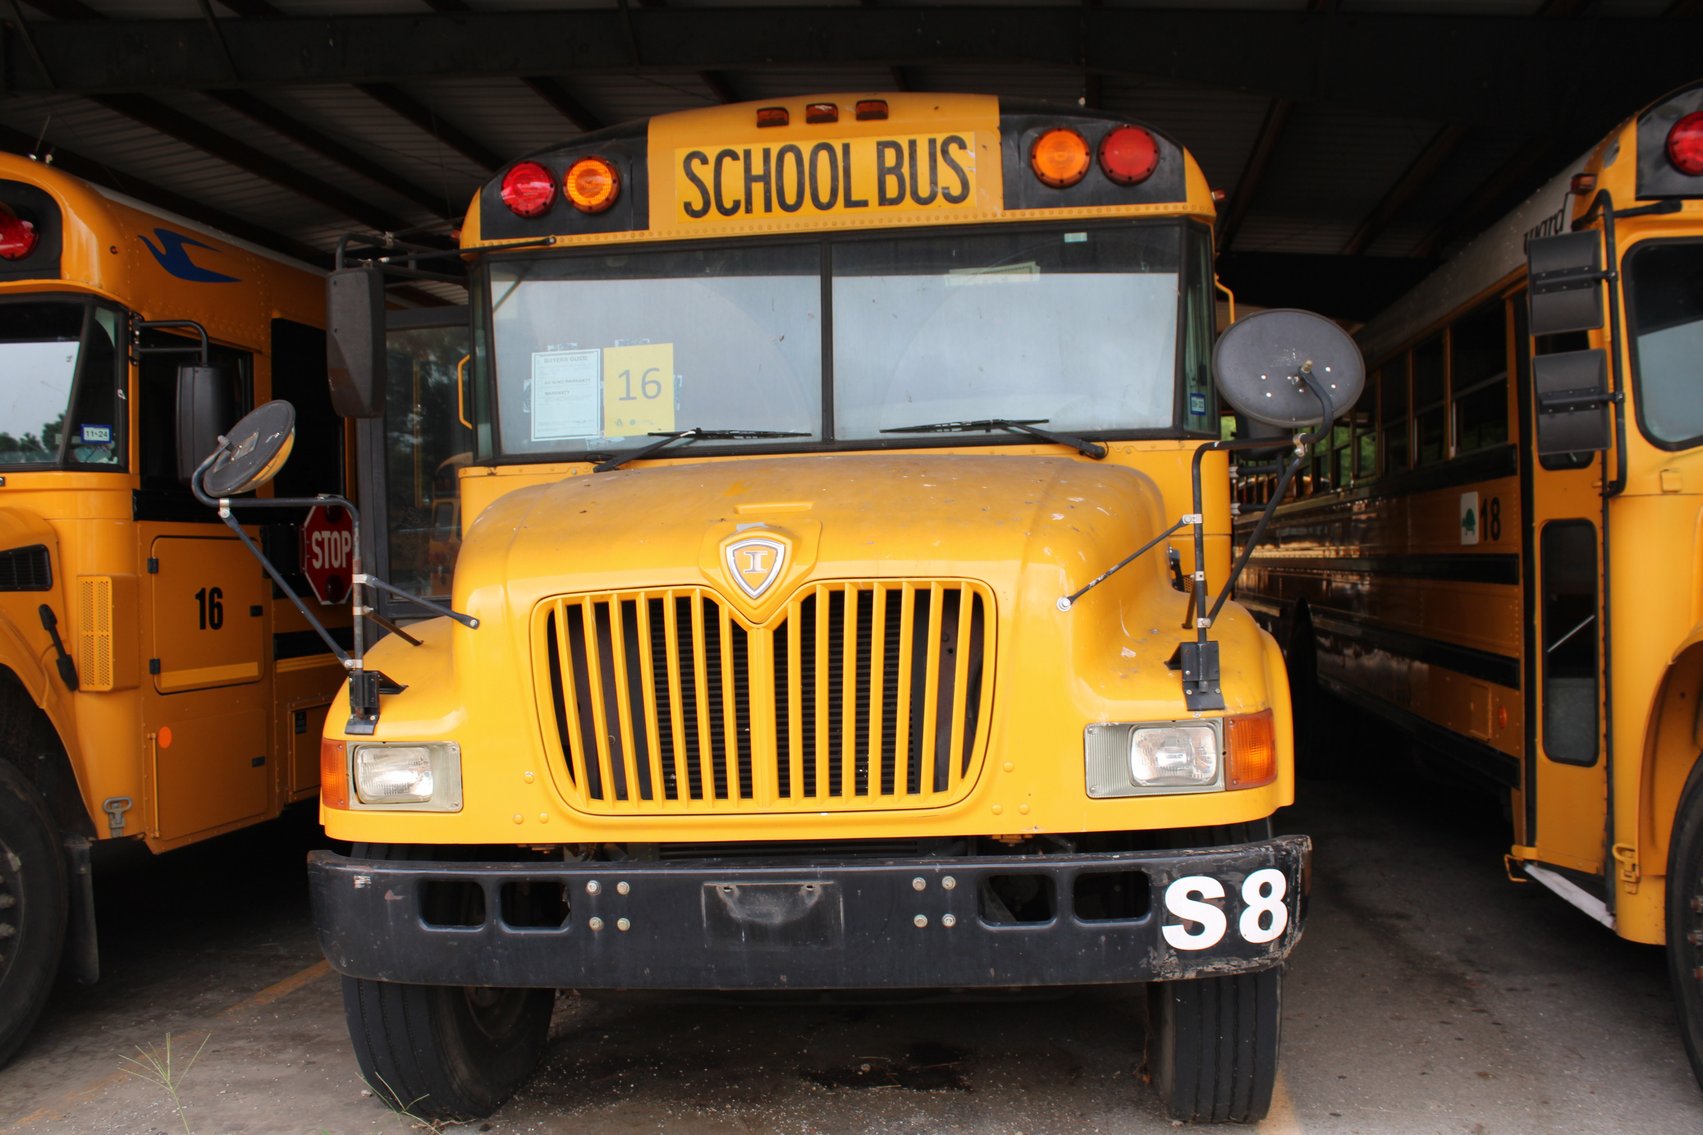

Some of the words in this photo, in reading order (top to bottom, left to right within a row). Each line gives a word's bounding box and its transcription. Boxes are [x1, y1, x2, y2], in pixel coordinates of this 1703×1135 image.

[683, 142, 869, 219] SCHOOL
[876, 135, 971, 207] BUS
[618, 367, 662, 401] 16
[1480, 496, 1501, 541] 18
[311, 530, 351, 569] STOP
[195, 587, 223, 630] 16
[1161, 868, 1288, 951] S8
